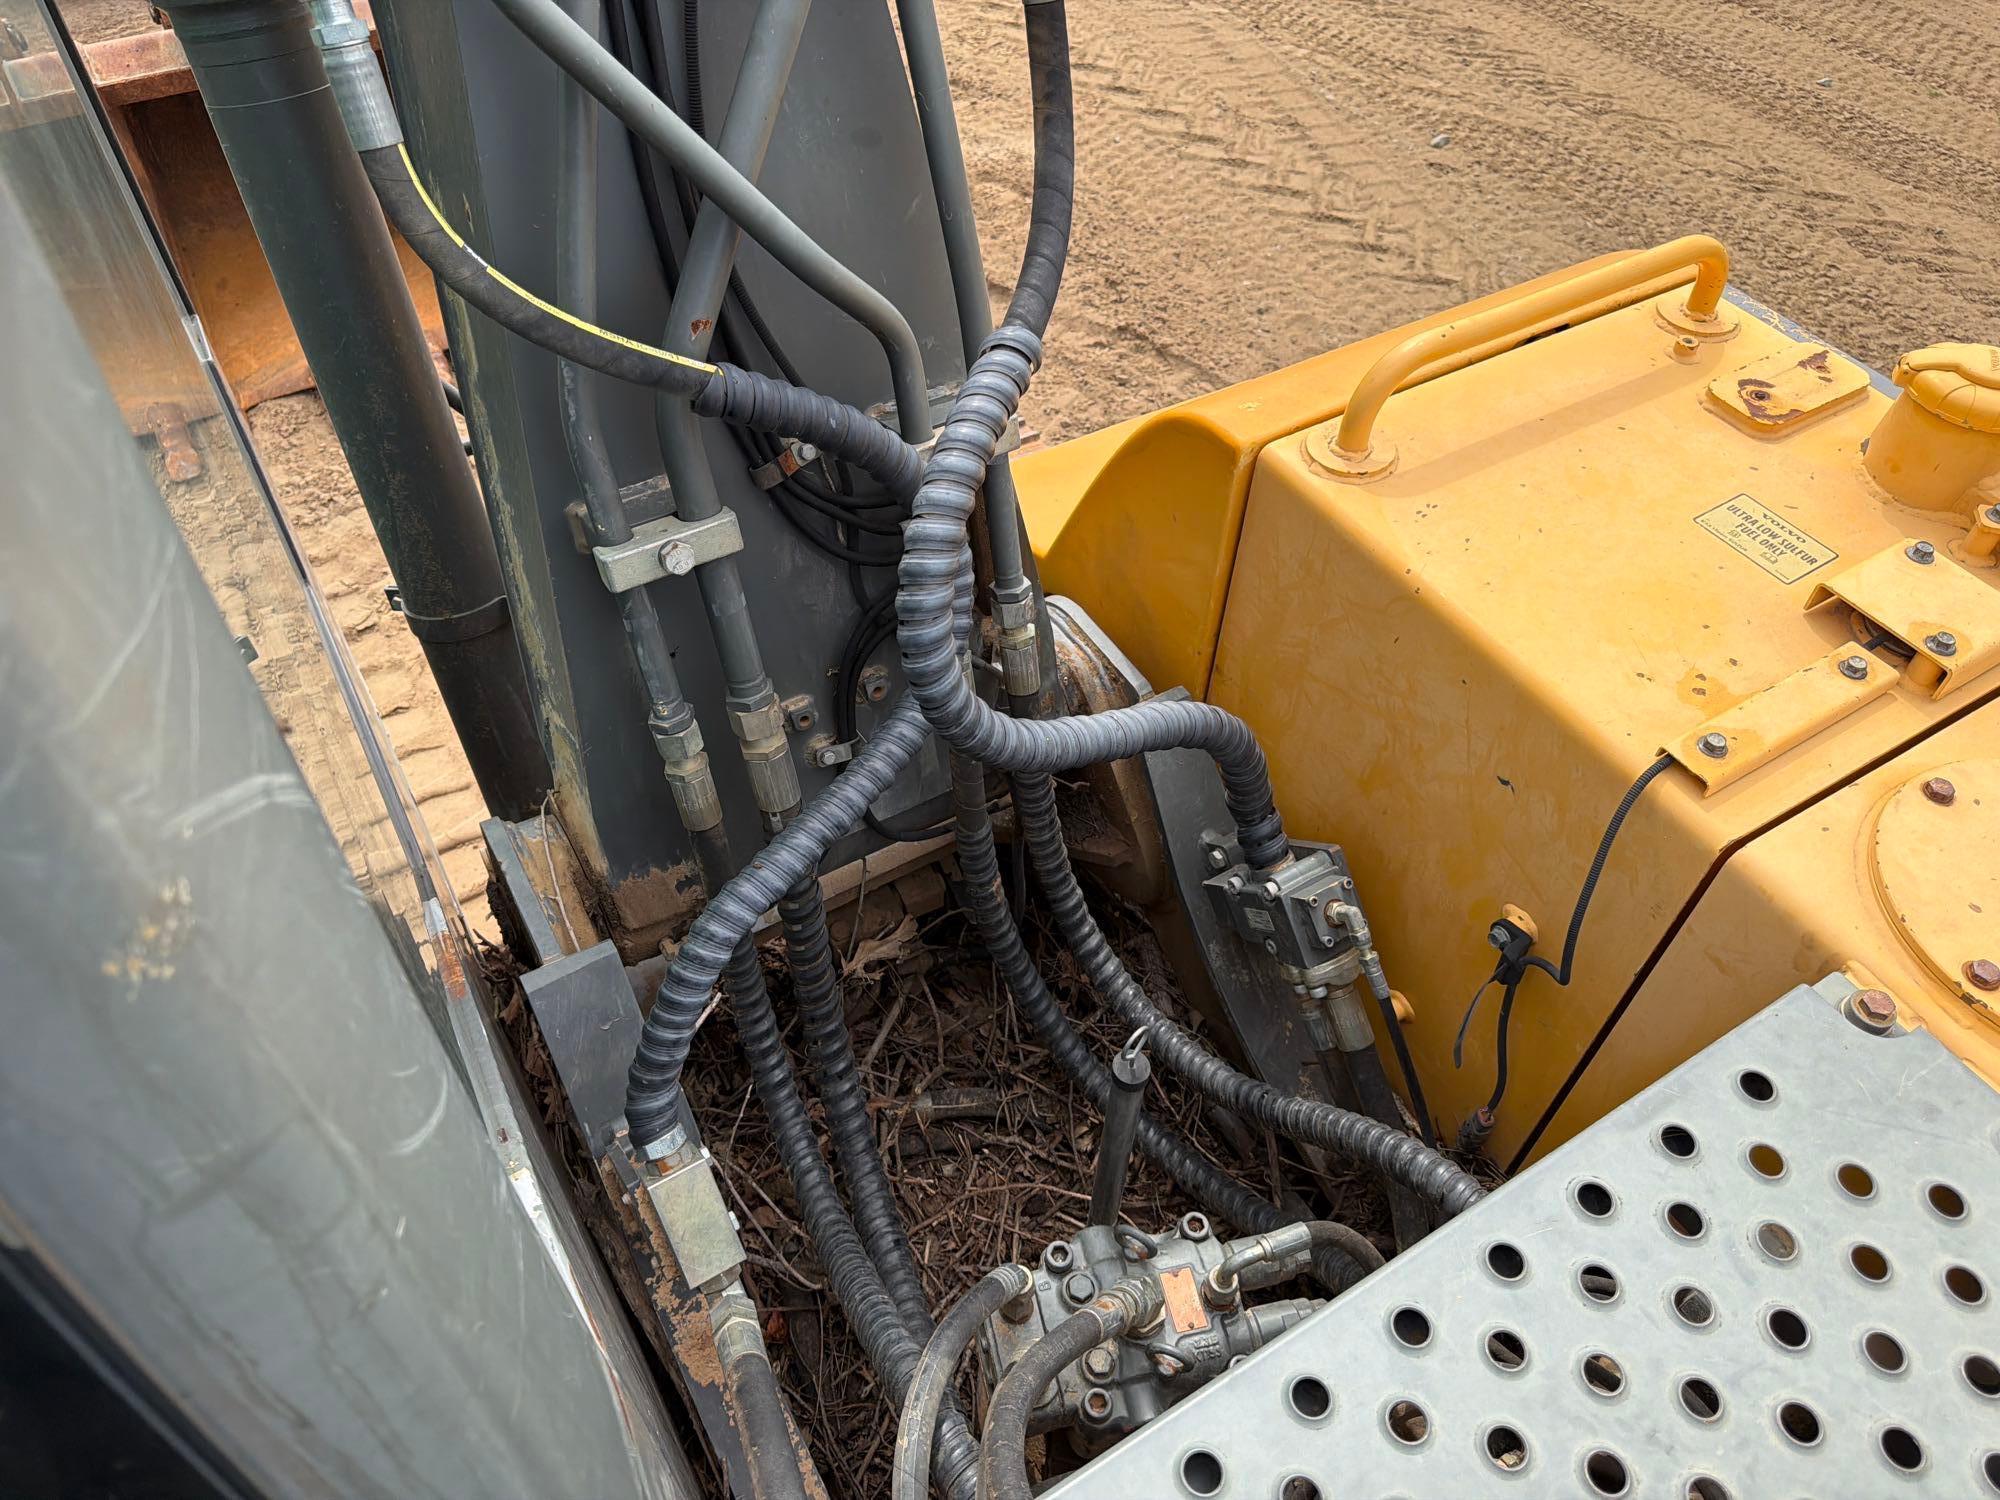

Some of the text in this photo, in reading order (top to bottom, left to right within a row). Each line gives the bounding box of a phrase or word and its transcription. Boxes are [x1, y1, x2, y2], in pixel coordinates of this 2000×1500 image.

[1727, 504, 1758, 528] ULTRA
[1757, 524, 1781, 539] LOW
[1780, 538, 1818, 566] SULFUR
[1735, 523, 1759, 541] FUEL
[1759, 539, 1788, 557] ONLY
[1762, 513, 1807, 544] VOLVO
